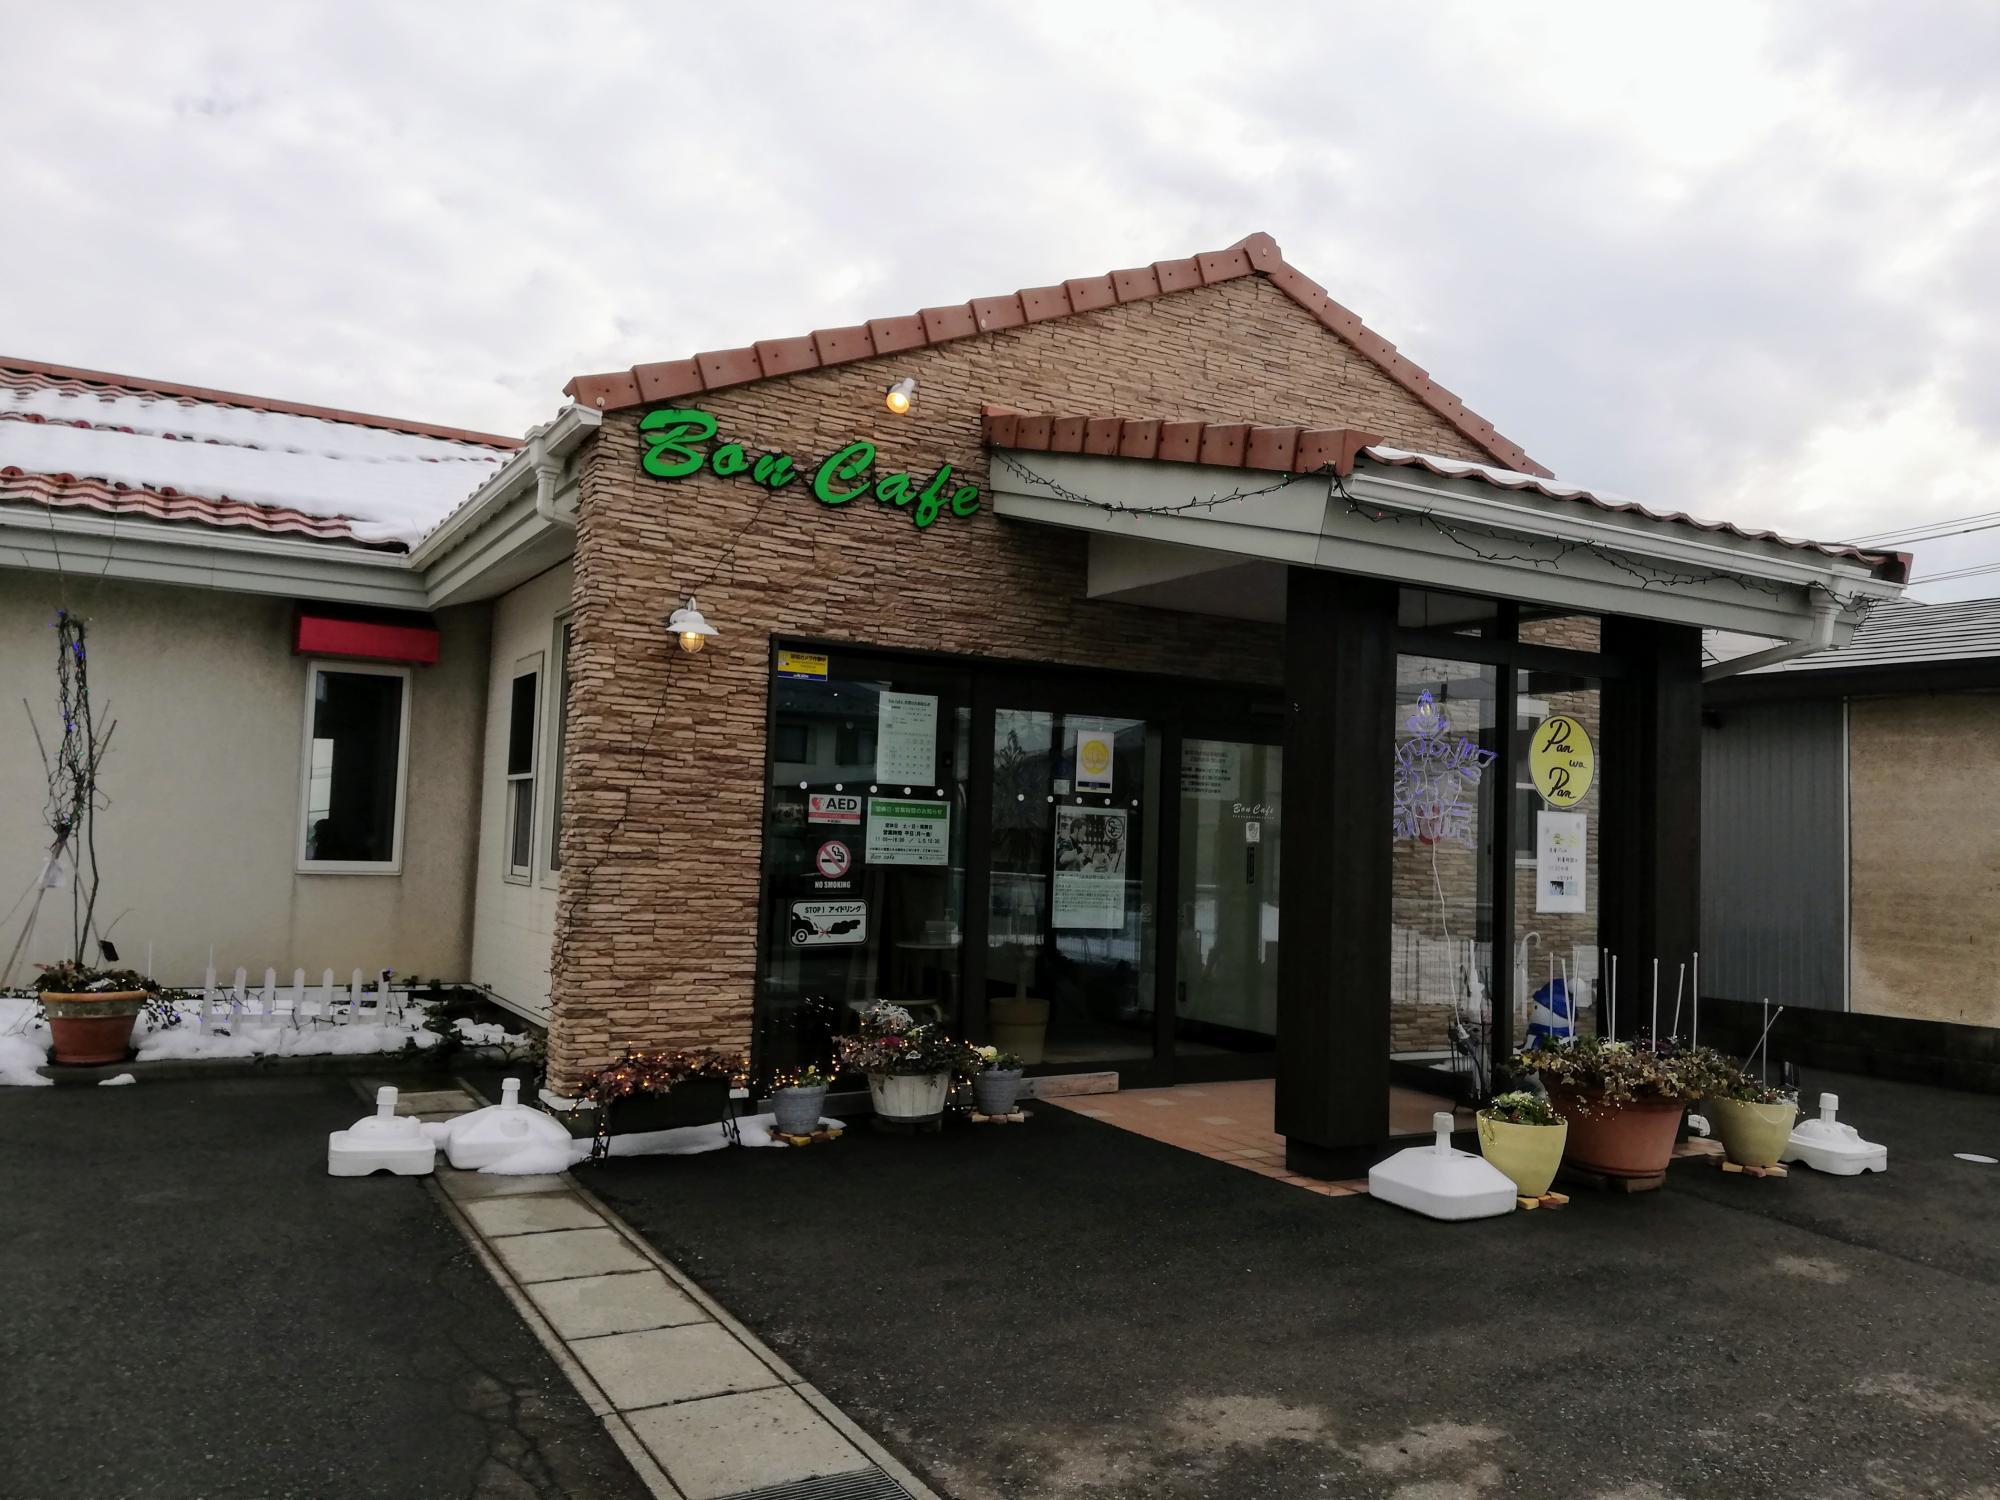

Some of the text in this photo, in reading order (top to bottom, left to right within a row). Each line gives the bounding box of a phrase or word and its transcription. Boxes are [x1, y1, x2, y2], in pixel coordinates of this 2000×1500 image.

[639, 408, 981, 529] Bon Cafe
[1542, 718, 1574, 753] Pan
[1568, 759, 1587, 769] wa
[1547, 766, 1577, 799] Pan
[826, 797, 857, 810] AED
[1232, 802, 1251, 814] Bon
[814, 881, 851, 889] NO SMOKING
[828, 905, 862, 913] アイドリング
